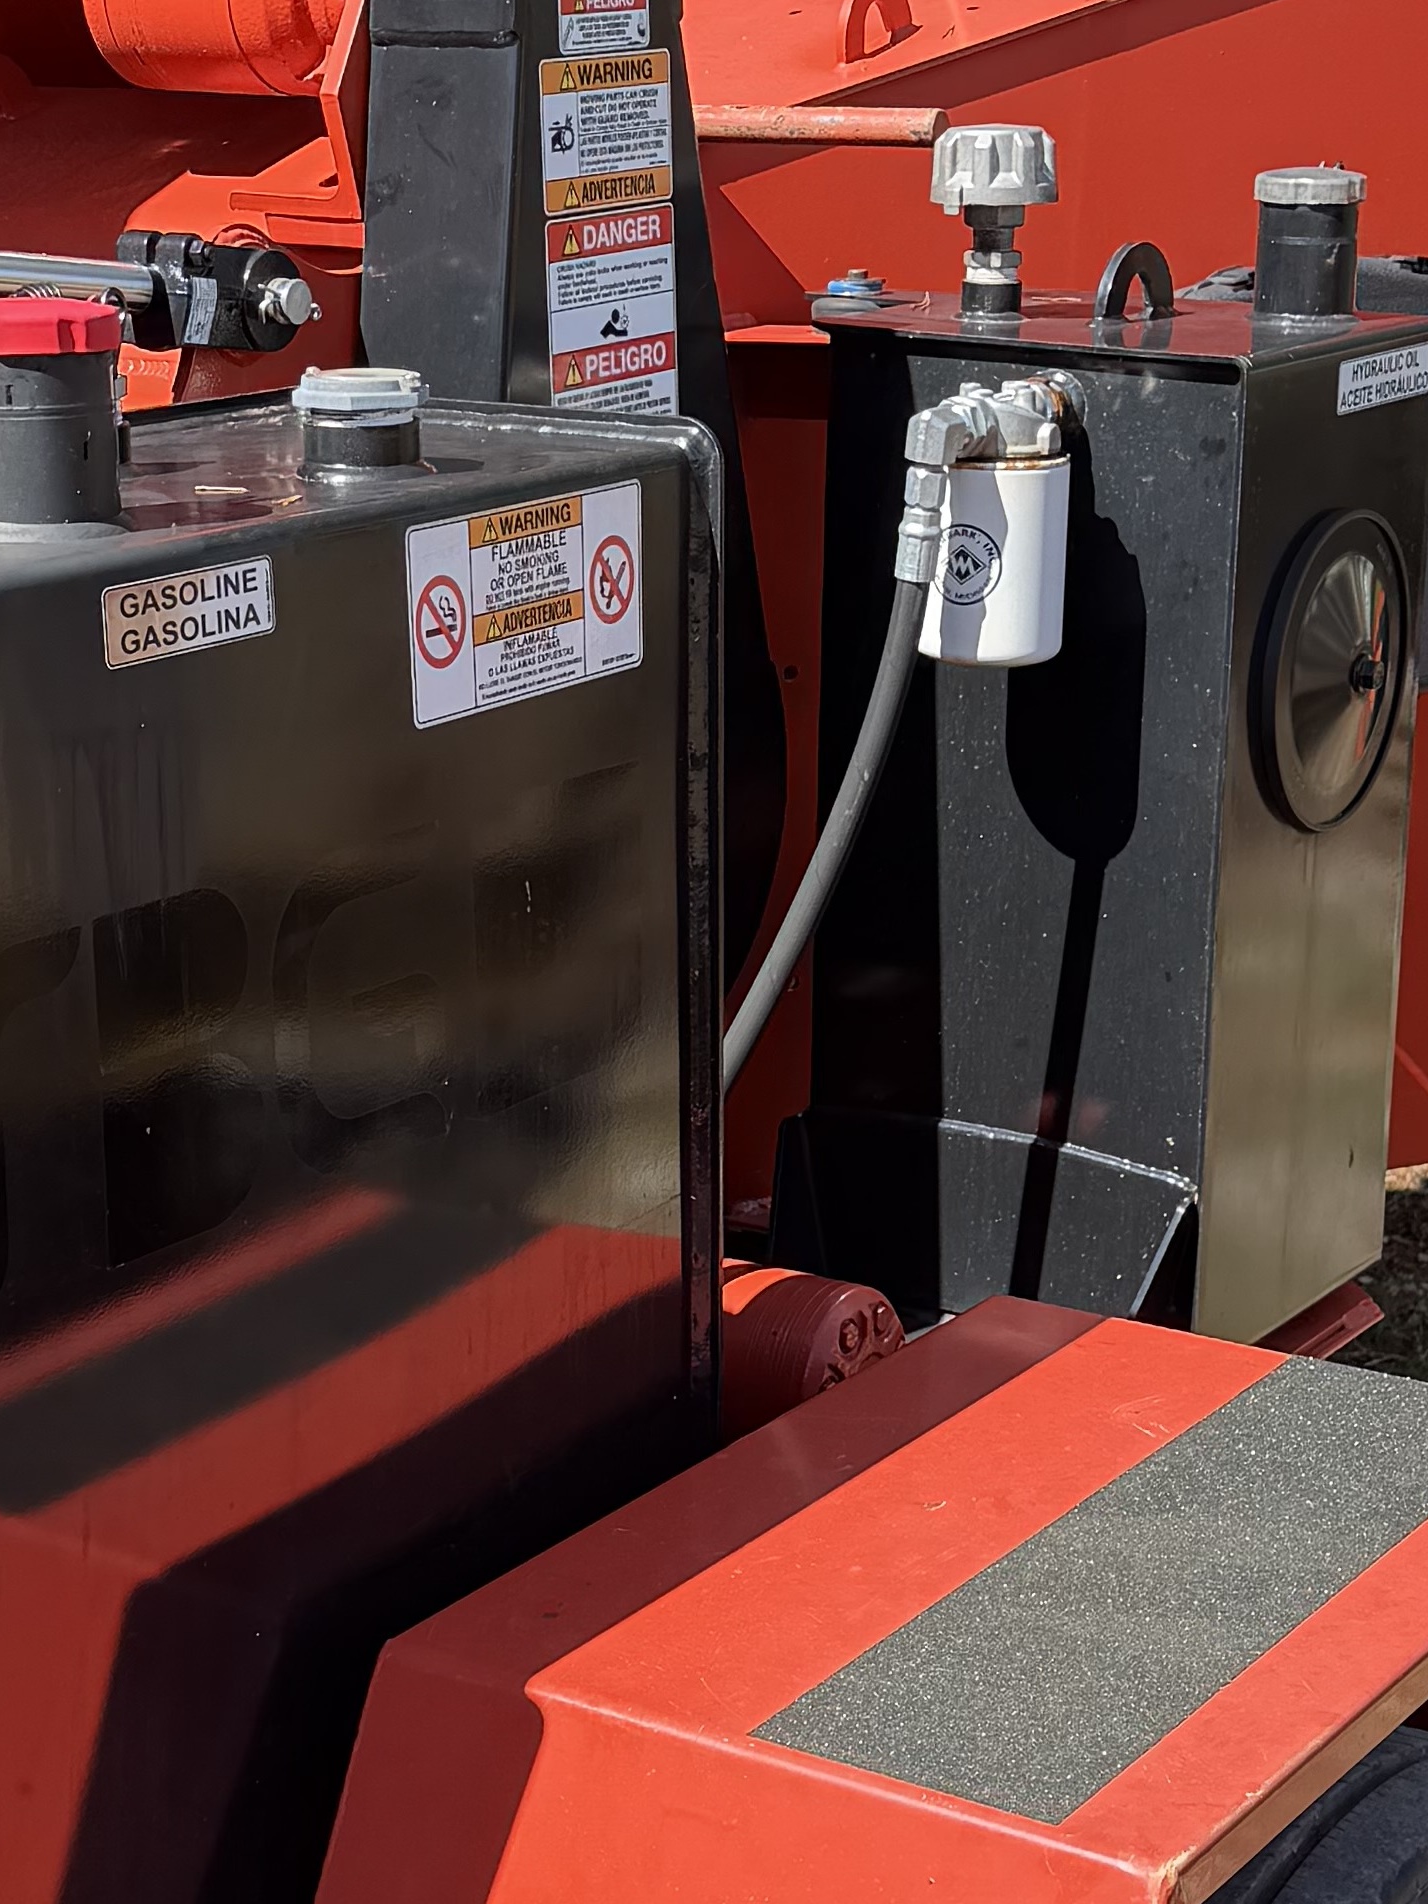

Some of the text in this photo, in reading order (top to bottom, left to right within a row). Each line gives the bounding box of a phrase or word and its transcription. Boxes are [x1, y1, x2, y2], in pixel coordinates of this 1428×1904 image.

[578, 58, 652, 86] WARNING
[582, 174, 656, 204] ADVERTENCIA
[583, 214, 660, 251] DANGER
[586, 340, 666, 380] PELIGRO
[1352, 350, 1420, 382] HYDRAULIC OIL
[1340, 385, 1372, 409] ACEITE
[499, 503, 571, 536] WARNING
[492, 530, 567, 562] FLAMMABLE
[490, 562, 568, 592] OR OPEN FLAME
[498, 550, 560, 576] NO SMOKING
[120, 568, 258, 618] GASOLINE
[121, 603, 260, 654] GASOLINA
[504, 598, 572, 634] ADVERTENCIA
[504, 627, 558, 651] INFLAMABLE
